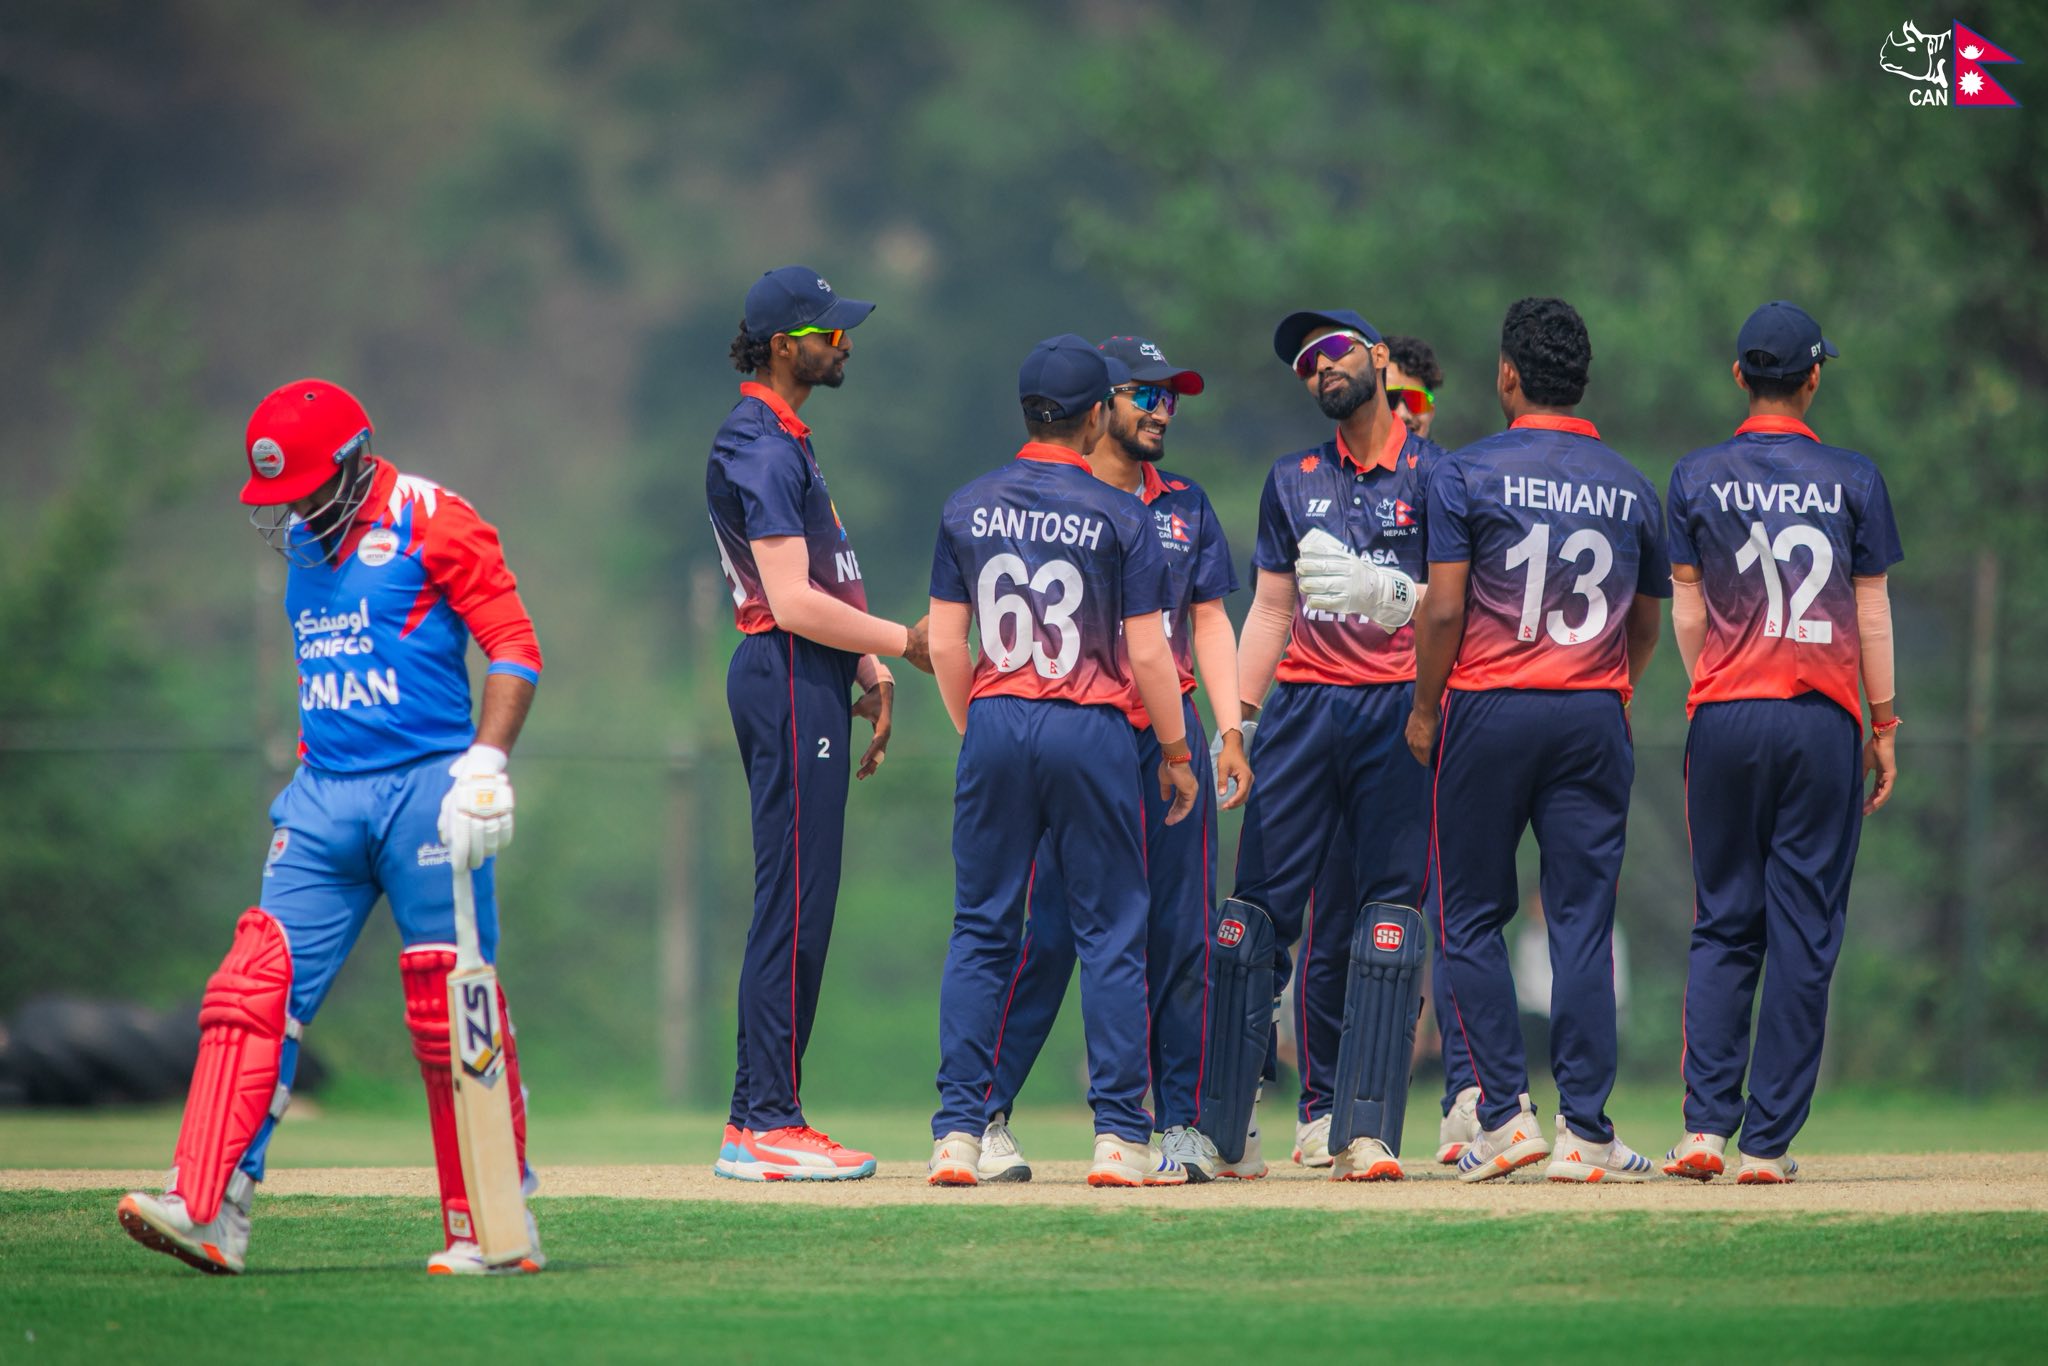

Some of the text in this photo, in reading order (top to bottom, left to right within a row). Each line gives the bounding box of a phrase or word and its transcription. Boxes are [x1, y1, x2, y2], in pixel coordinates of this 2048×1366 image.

[1504, 475, 1637, 521] HEMANT
[1711, 481, 1842, 514] YUVRAJ
[971, 507, 1103, 551] SANTOSH
[1381, 520, 1395, 528] CAN
[1383, 529, 1408, 537] NEPAL
[1505, 523, 1613, 646] 13
[1735, 521, 1834, 644] 12
[977, 553, 1084, 679] 63
[817, 737, 830, 758] 2
[1219, 925, 1240, 941] SS
[1376, 929, 1400, 945] SS
